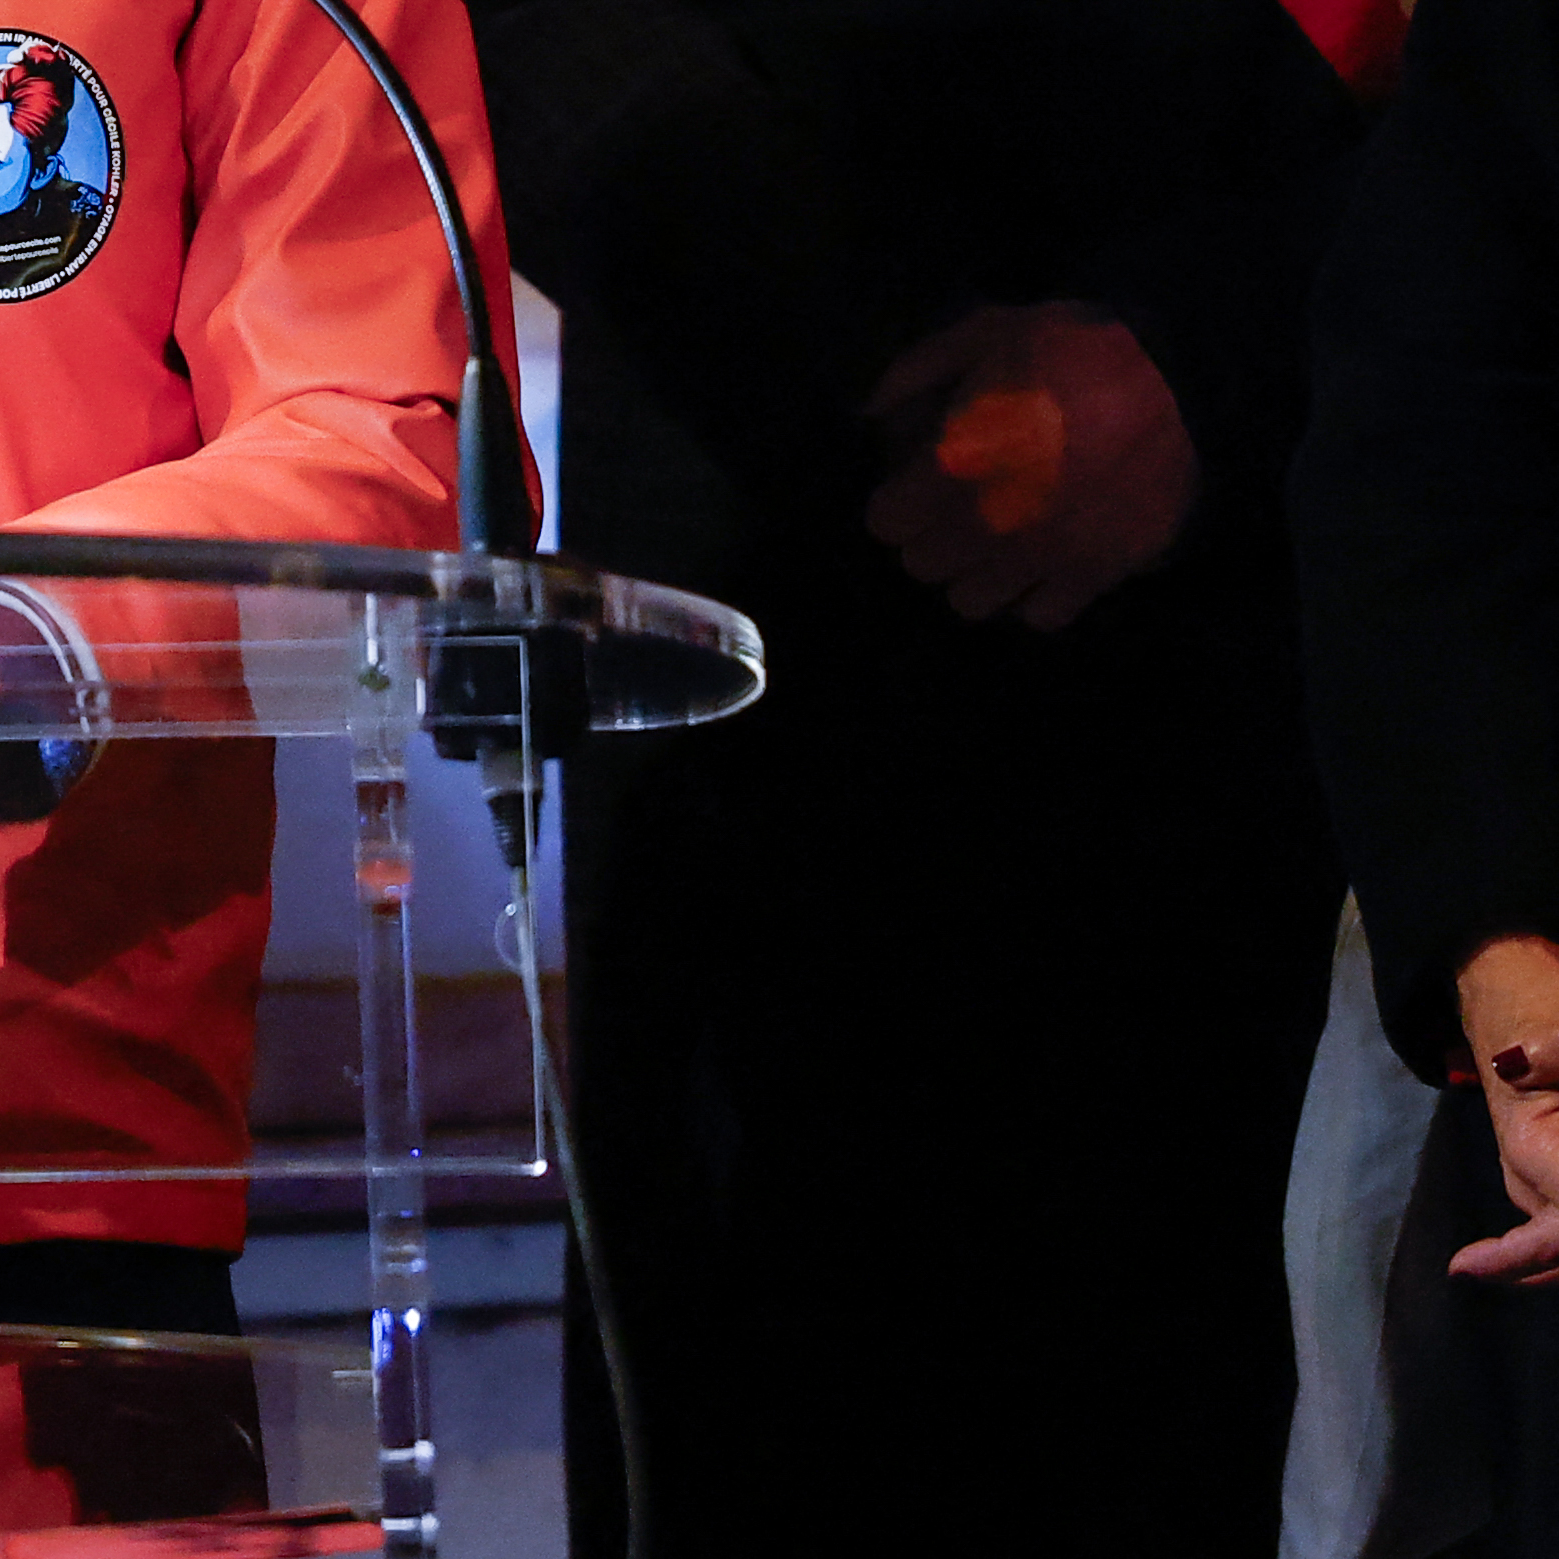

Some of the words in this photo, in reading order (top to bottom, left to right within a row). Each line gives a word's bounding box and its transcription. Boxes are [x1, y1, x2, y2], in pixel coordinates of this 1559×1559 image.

[88, 77, 108, 109] POUR
[103, 108, 120, 149] CÉCILE
[109, 151, 121, 197] KOHLER
[93, 204, 115, 242] OTAGE
[64, 251, 88, 276] IRAN
[84, 239, 98, 256] EN
[19, 273, 61, 299] LIBERTÉ
